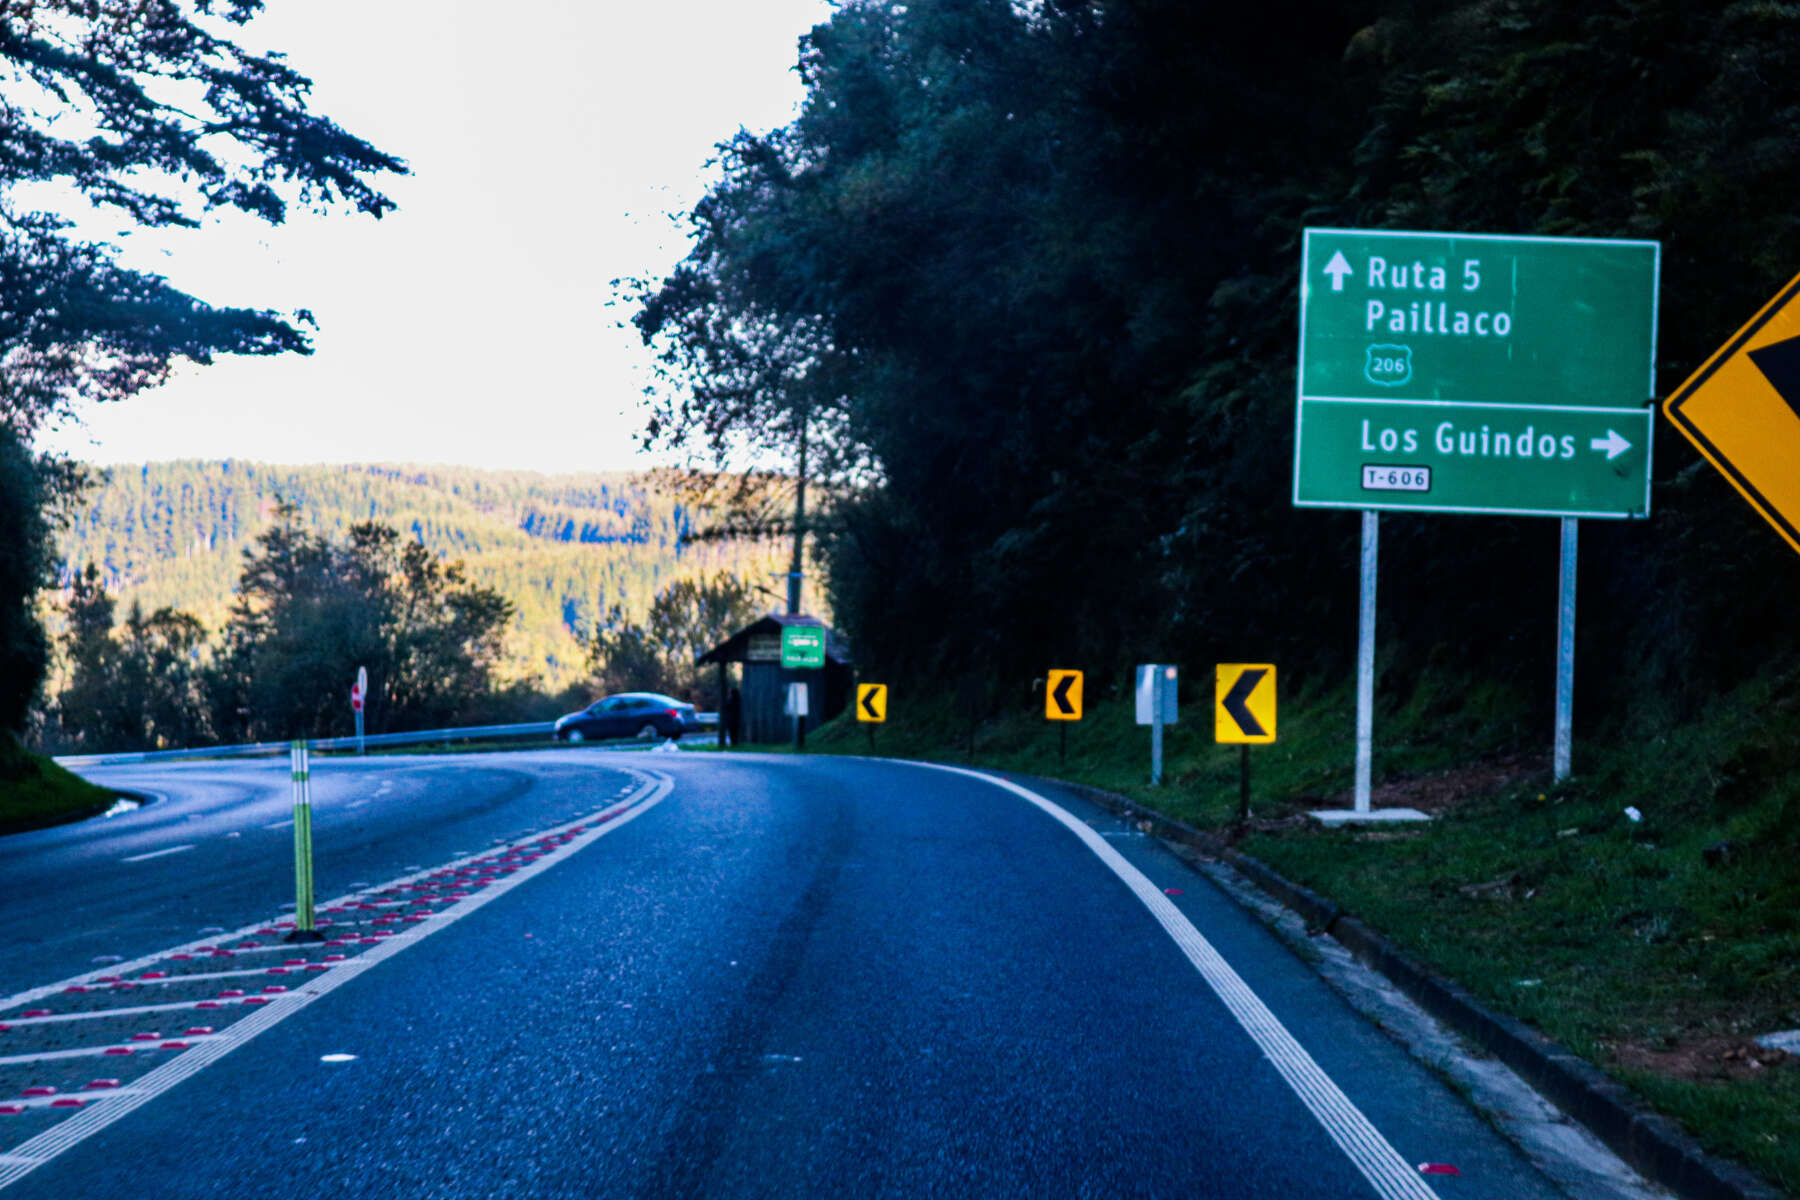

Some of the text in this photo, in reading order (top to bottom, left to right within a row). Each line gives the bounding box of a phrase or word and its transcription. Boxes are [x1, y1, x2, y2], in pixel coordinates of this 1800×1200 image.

[1368, 256, 1480, 291] Ruta 5
[1366, 300, 1512, 335] Paillaco
[1373, 357, 1405, 372] 206
[1361, 420, 1576, 458] Los Guindos
[1368, 470, 1426, 486] T-606
